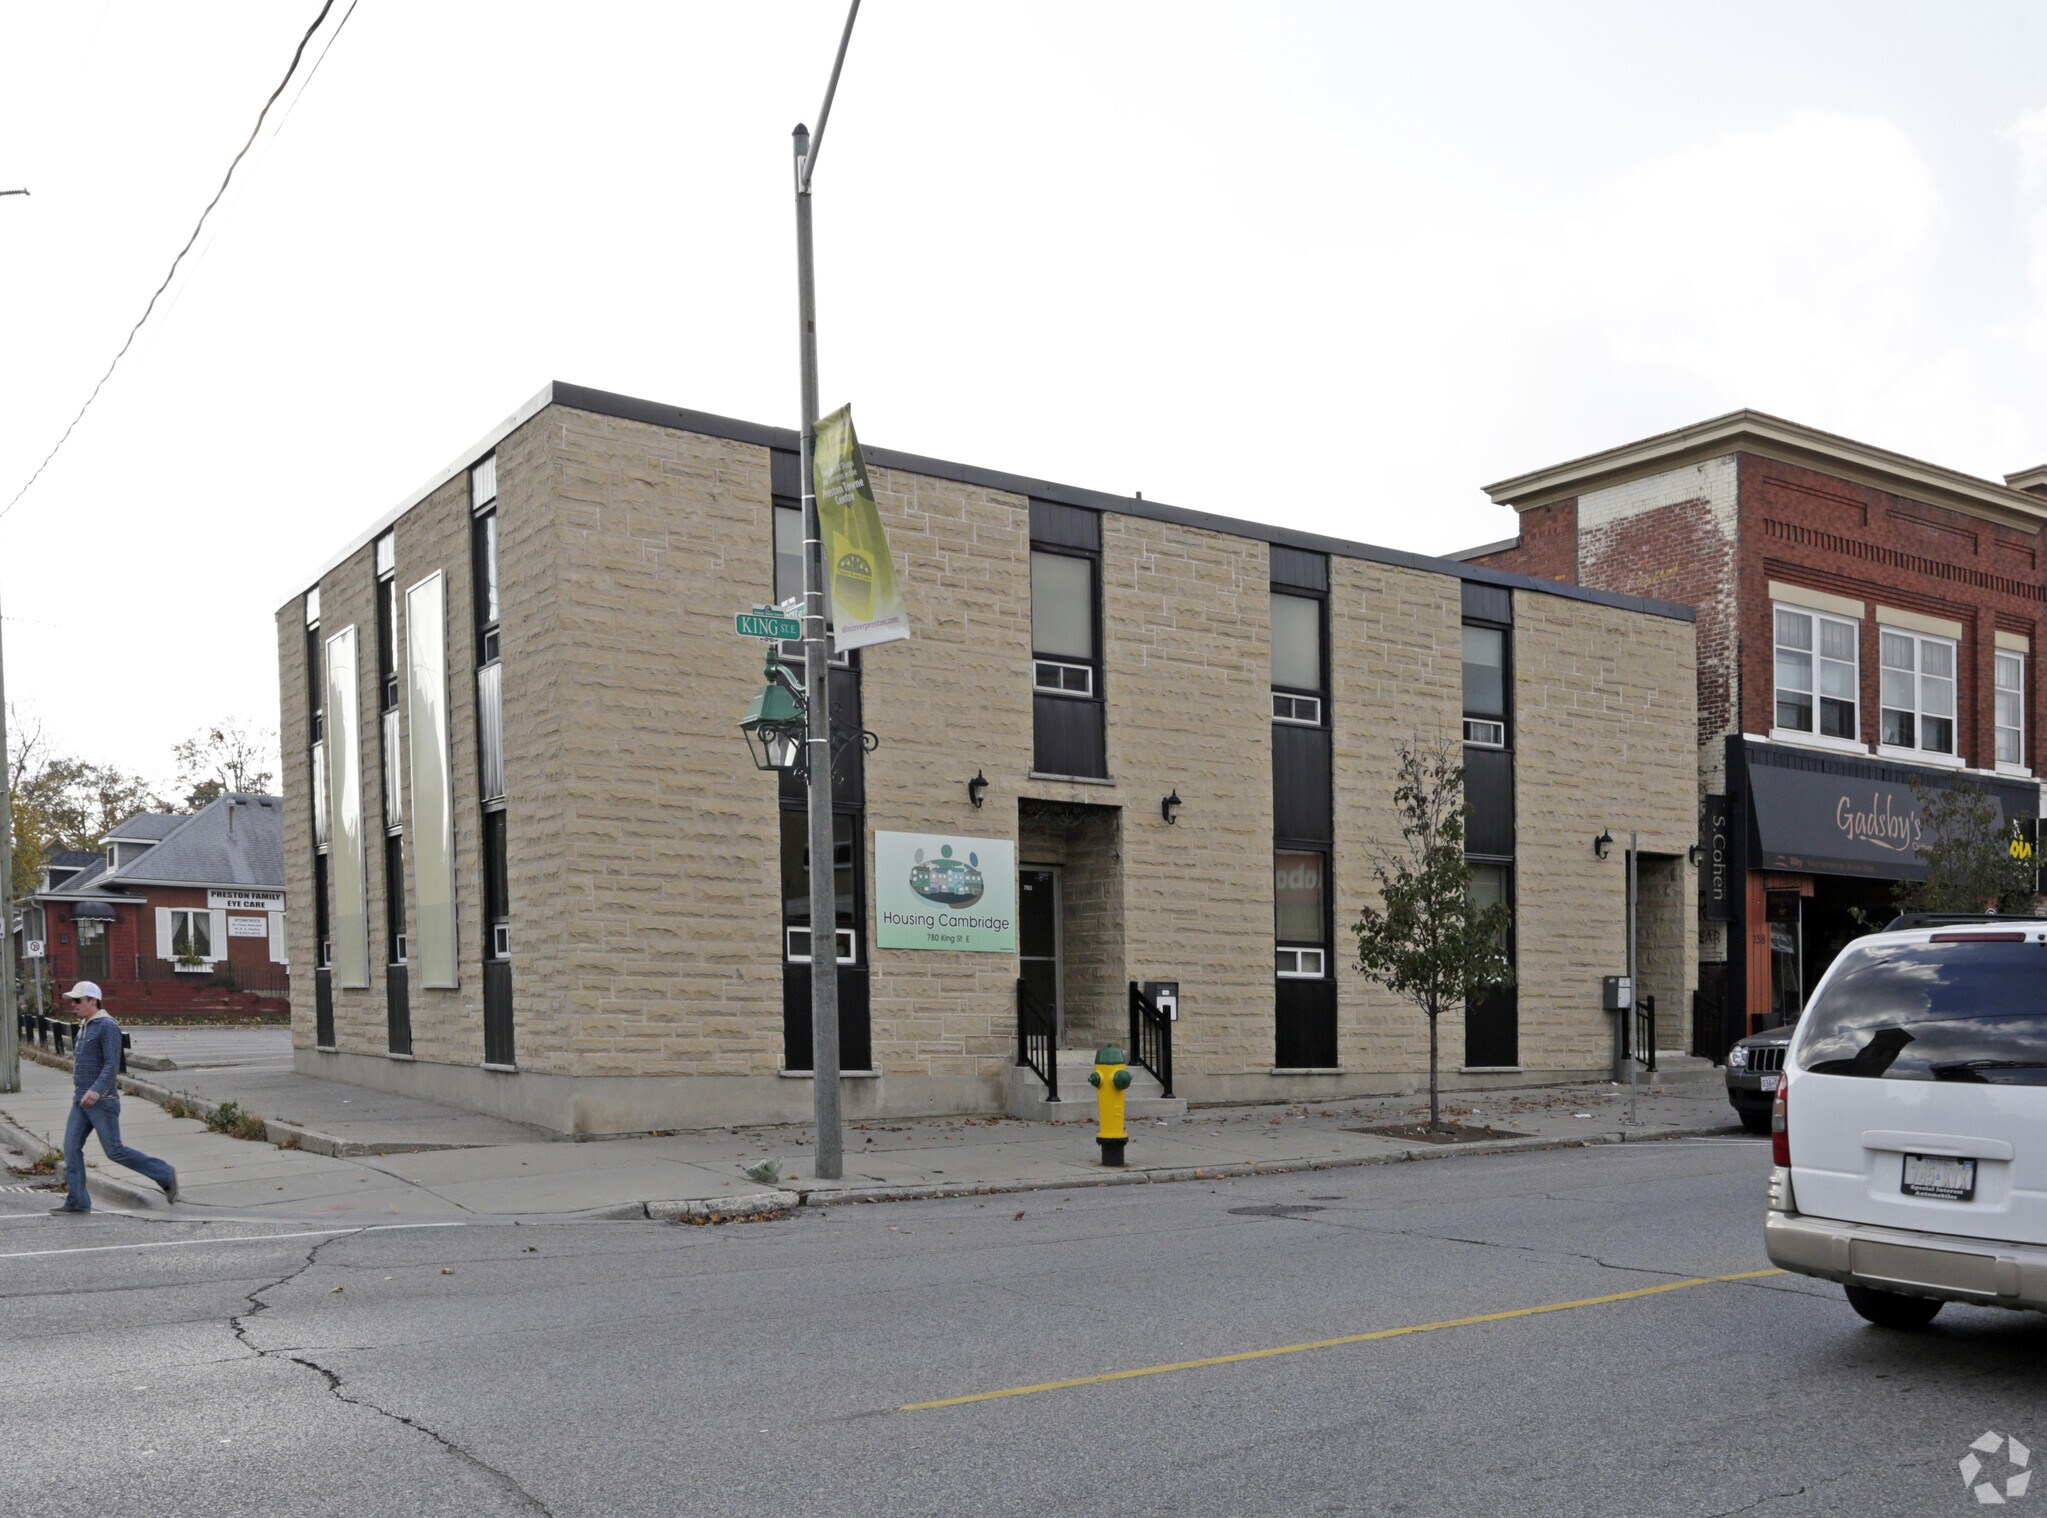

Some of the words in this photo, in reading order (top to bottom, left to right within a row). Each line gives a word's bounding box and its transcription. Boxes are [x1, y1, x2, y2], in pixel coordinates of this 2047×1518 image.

[822, 485, 844, 499] Preston
[842, 478, 865, 492] Towne
[834, 492, 855, 505] Centre
[742, 616, 778, 636] KING
[841, 616, 900, 633] discoverpreston.com
[1837, 792, 1922, 850] Gadsby's
[210, 890, 250, 899] PRESTON
[251, 892, 281, 900] FAMILY
[883, 911, 935, 929] Housing
[939, 913, 1010, 932] Cambridge
[927, 933, 939, 941] 780
[940, 934, 955, 944] King
[1914, 1190, 1958, 1200] Automobiles
[1935, 1186, 1964, 1195] Interest
